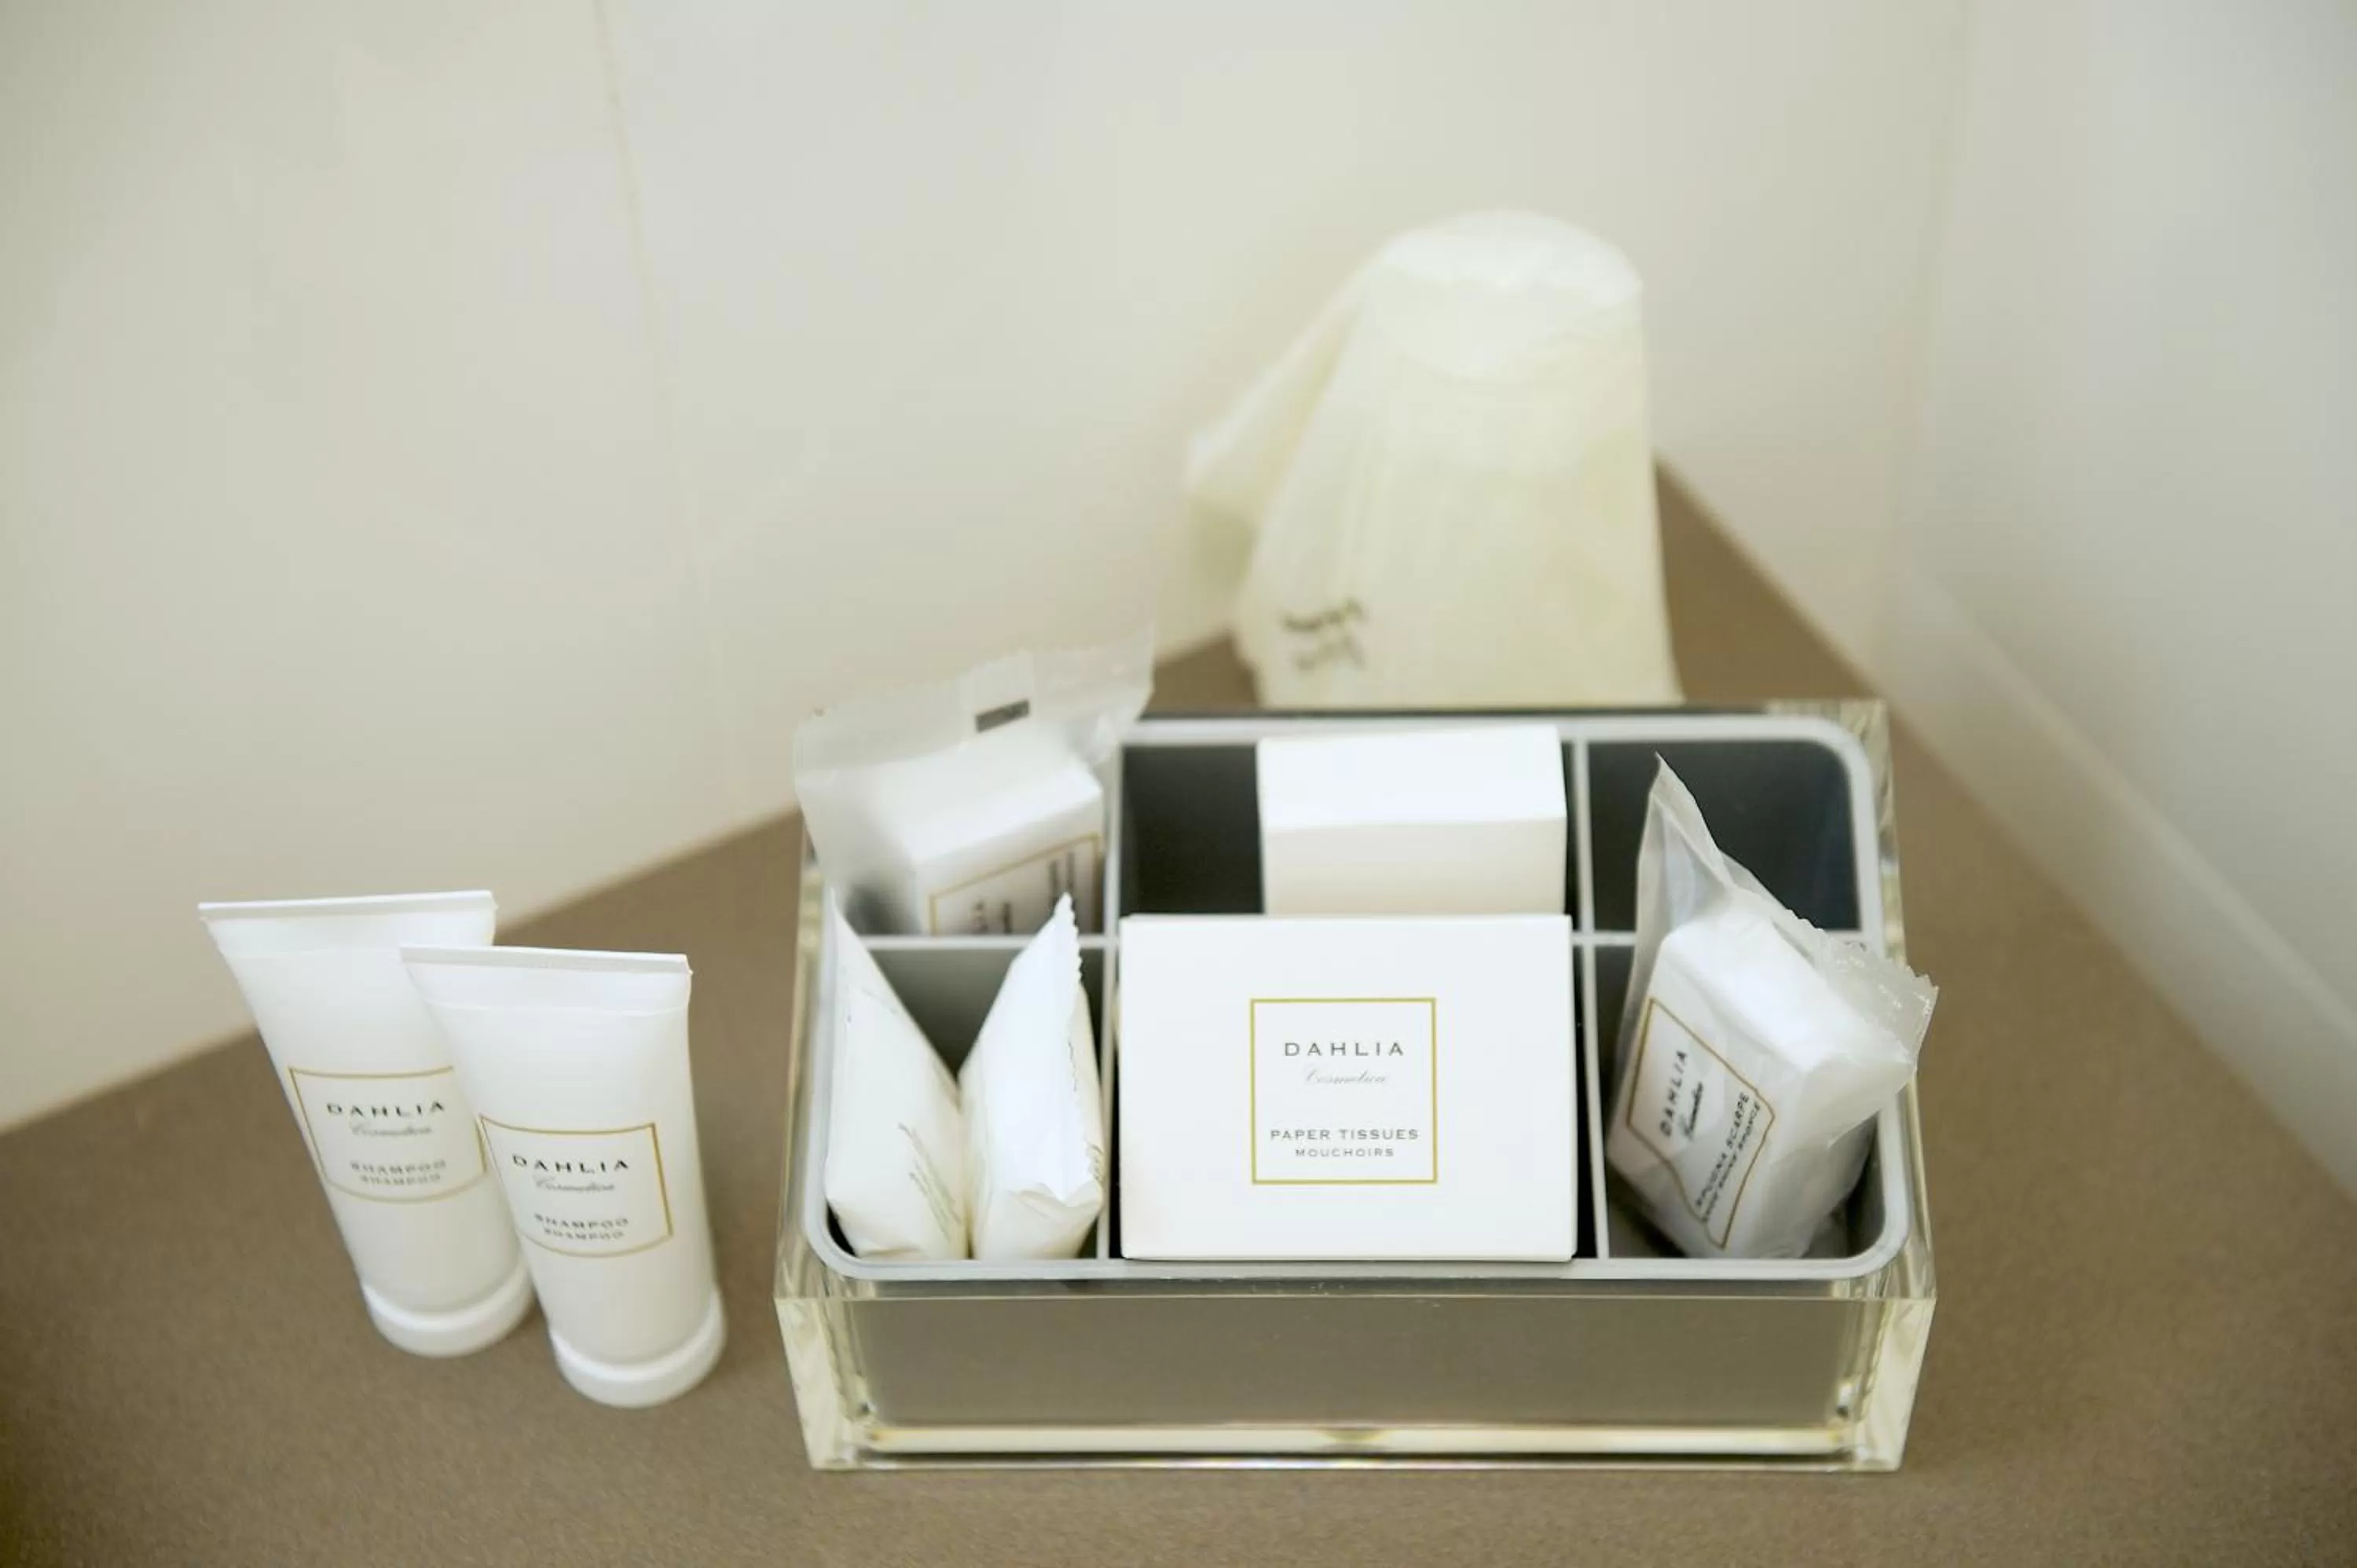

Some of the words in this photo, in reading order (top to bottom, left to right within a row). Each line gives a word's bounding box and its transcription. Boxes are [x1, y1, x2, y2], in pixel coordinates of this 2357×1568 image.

[1284, 1042, 1404, 1057] DAHLIA
[1659, 1050, 1688, 1137] DAHLIA
[326, 1101, 445, 1118] DAHLIA
[1270, 1130, 1331, 1141] PAPER
[1338, 1129, 1420, 1141] TISSUES
[1295, 1149, 1395, 1157] MOUCHOIRS
[350, 1160, 445, 1174] SHAMPOO
[512, 1154, 629, 1173] DAHLIA
[533, 1212, 629, 1229] SHAMPOO
